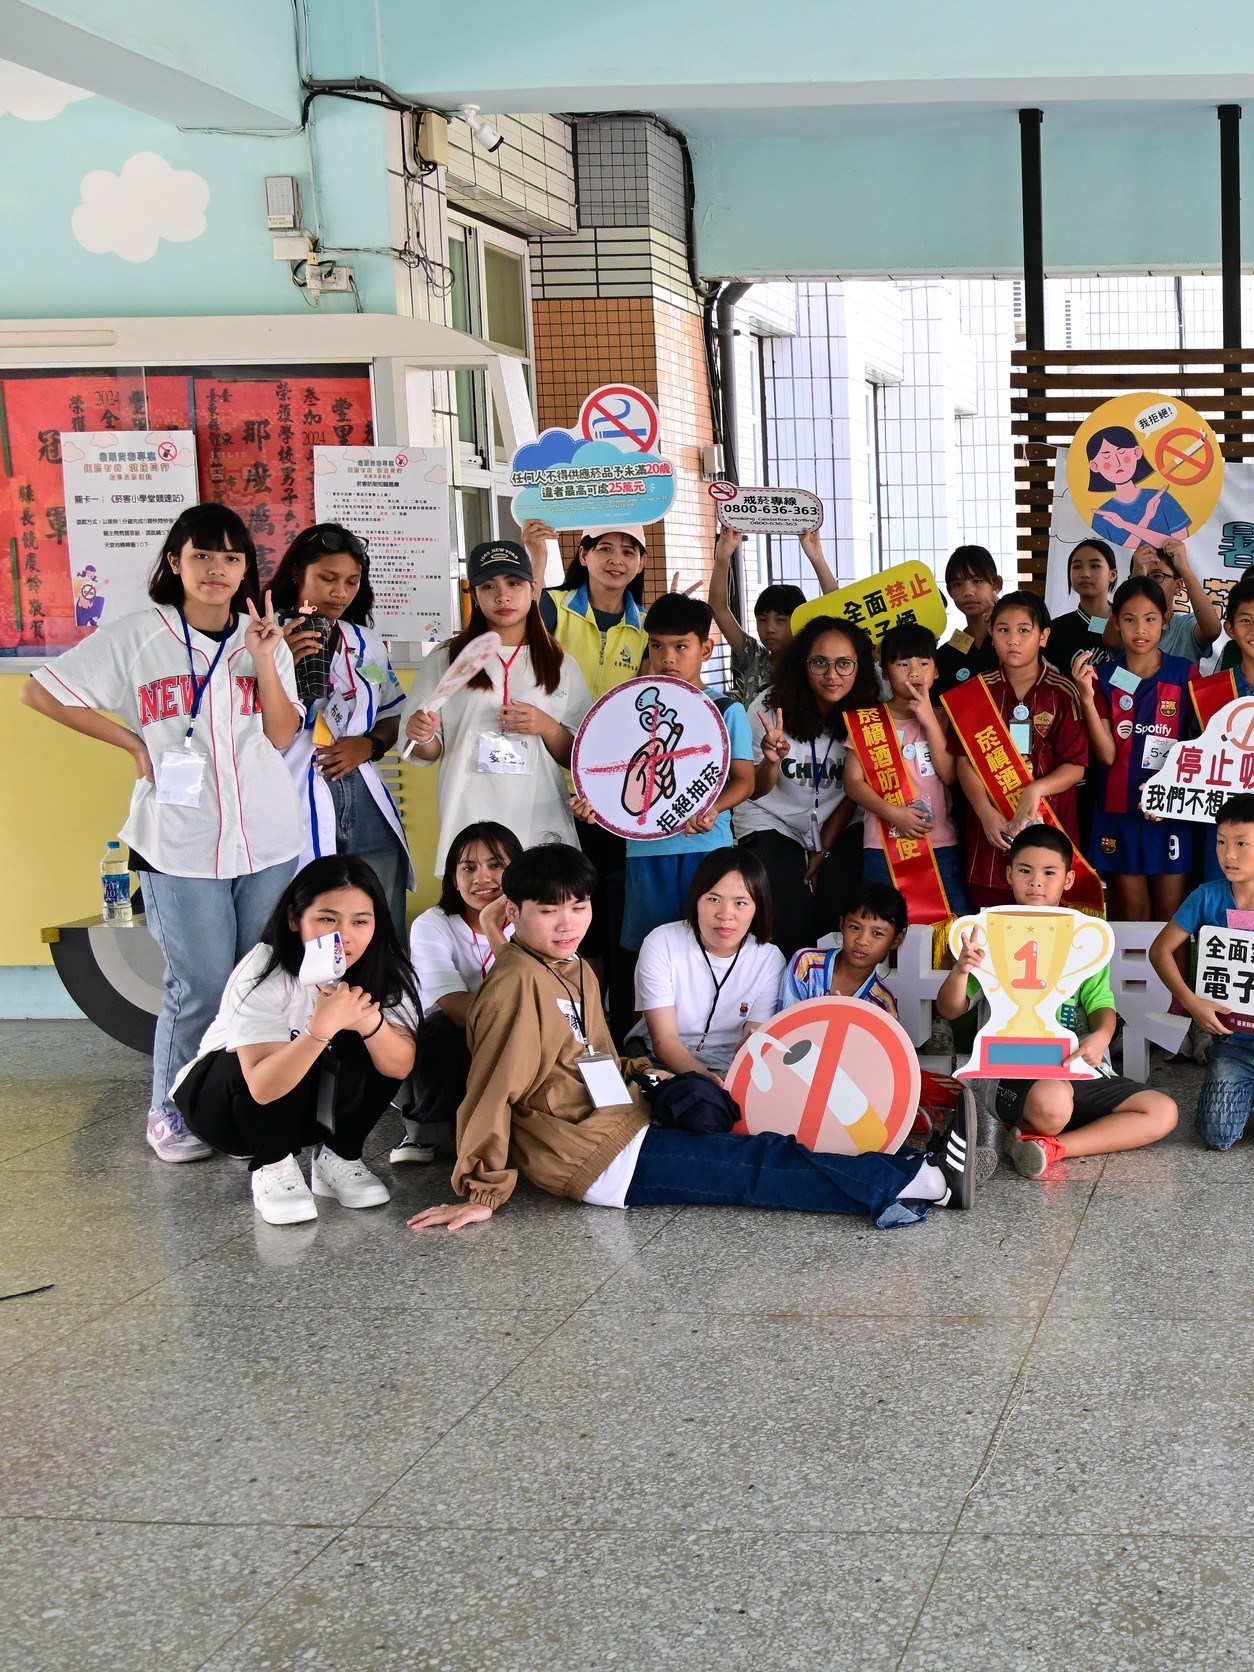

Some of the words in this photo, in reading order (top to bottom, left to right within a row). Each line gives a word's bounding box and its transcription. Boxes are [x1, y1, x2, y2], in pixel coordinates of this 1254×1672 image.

[1138, 406, 1173, 429] 我拒絕!
[511, 463, 672, 485] 任何人不得供應菸品予未滿20歲
[542, 481, 646, 499] 違者最高可處25萬元
[743, 495, 797, 506] 戒菸專線
[724, 504, 818, 516] 0800-636-363
[842, 572, 932, 624] 全面禁止
[138, 676, 203, 728] NEW
[1135, 723, 1172, 737] Spotify
[656, 761, 724, 835] 拒絕抽菸
[1168, 834, 1180, 861] 9
[1012, 940, 1048, 990] 1
